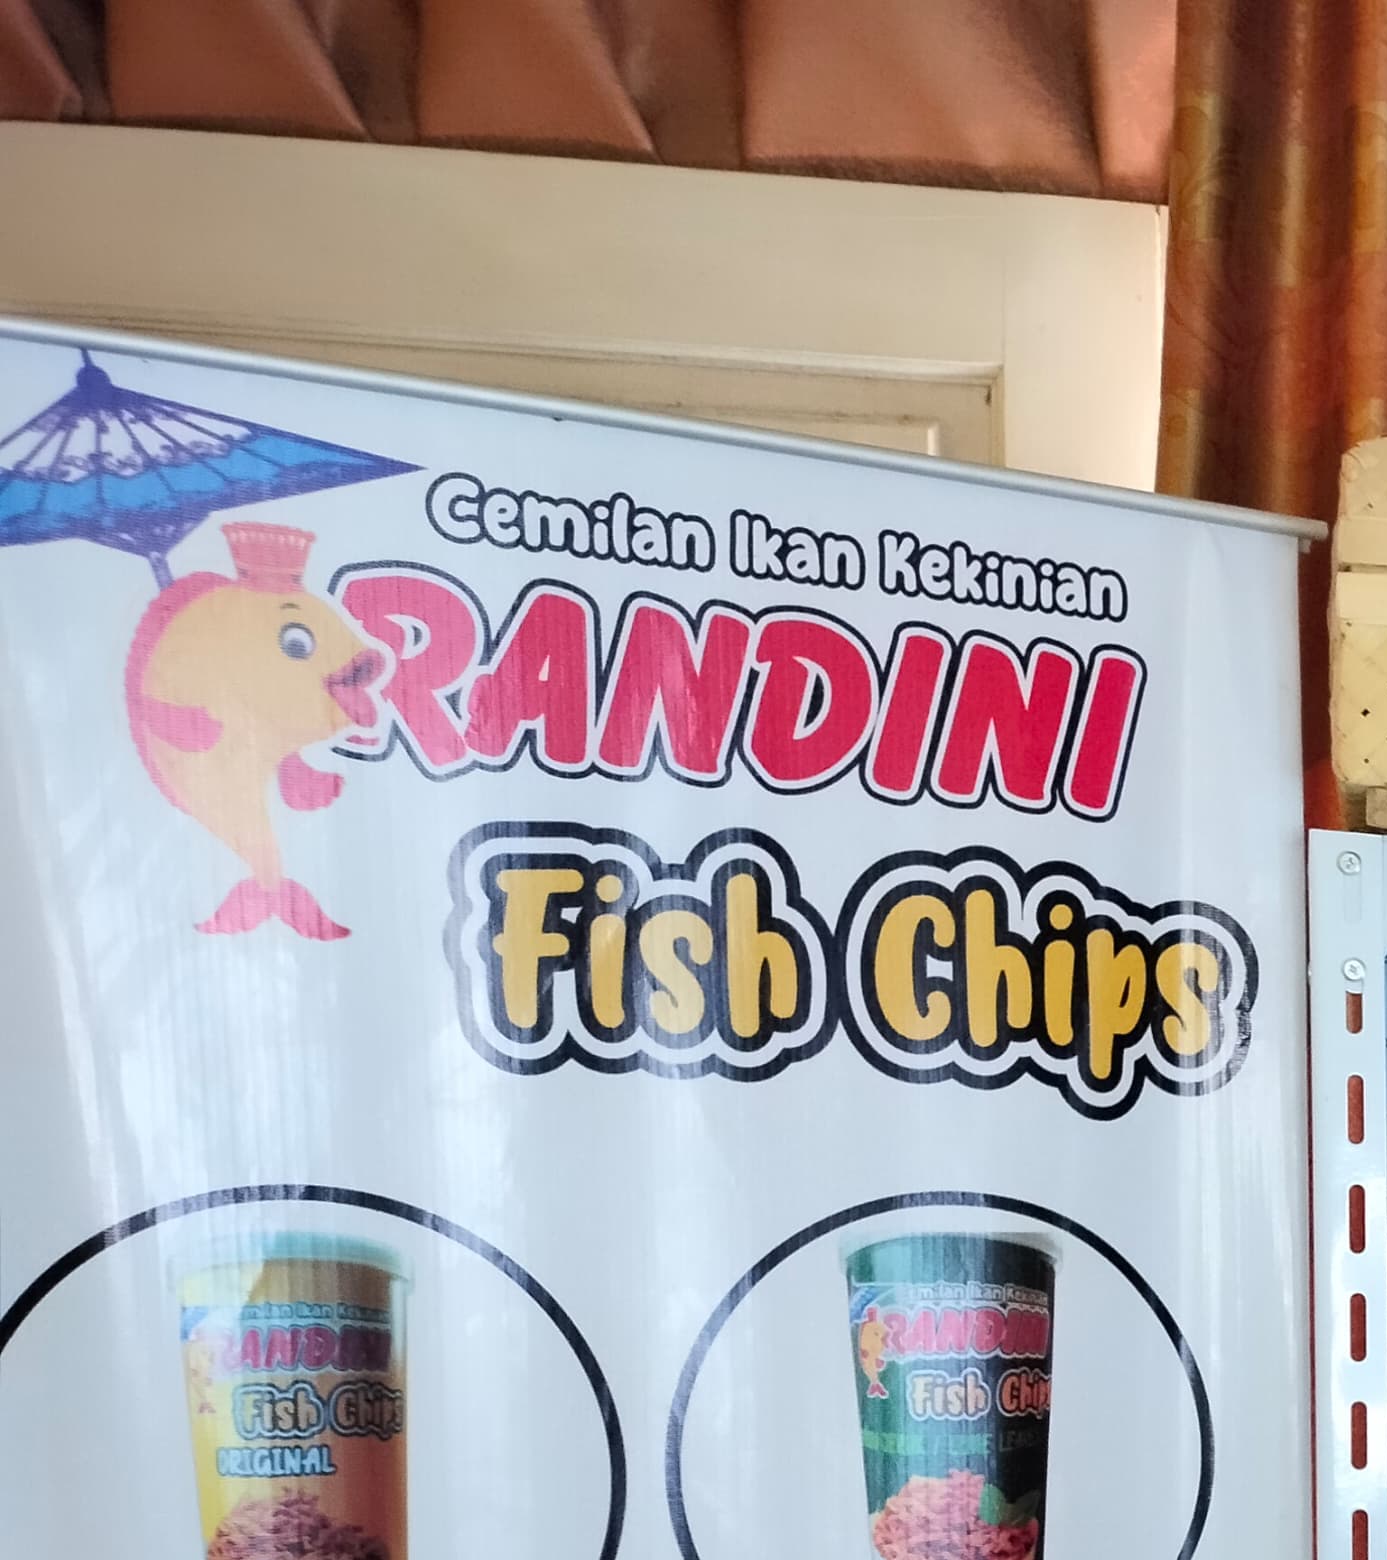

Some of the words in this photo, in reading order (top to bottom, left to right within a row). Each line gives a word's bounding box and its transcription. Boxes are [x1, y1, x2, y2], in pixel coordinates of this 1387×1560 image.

[427, 471, 716, 576] Cemilan
[729, 511, 868, 595] Ikan
[875, 530, 1129, 625] Kekinian
[335, 562, 1148, 823] RANDINI
[472, 843, 821, 1062] Fish
[858, 869, 1239, 1102] Chips
[236, 1384, 321, 1435] Fish
[908, 1369, 989, 1420] Fish
[217, 1447, 336, 1478] ORIGINAL
